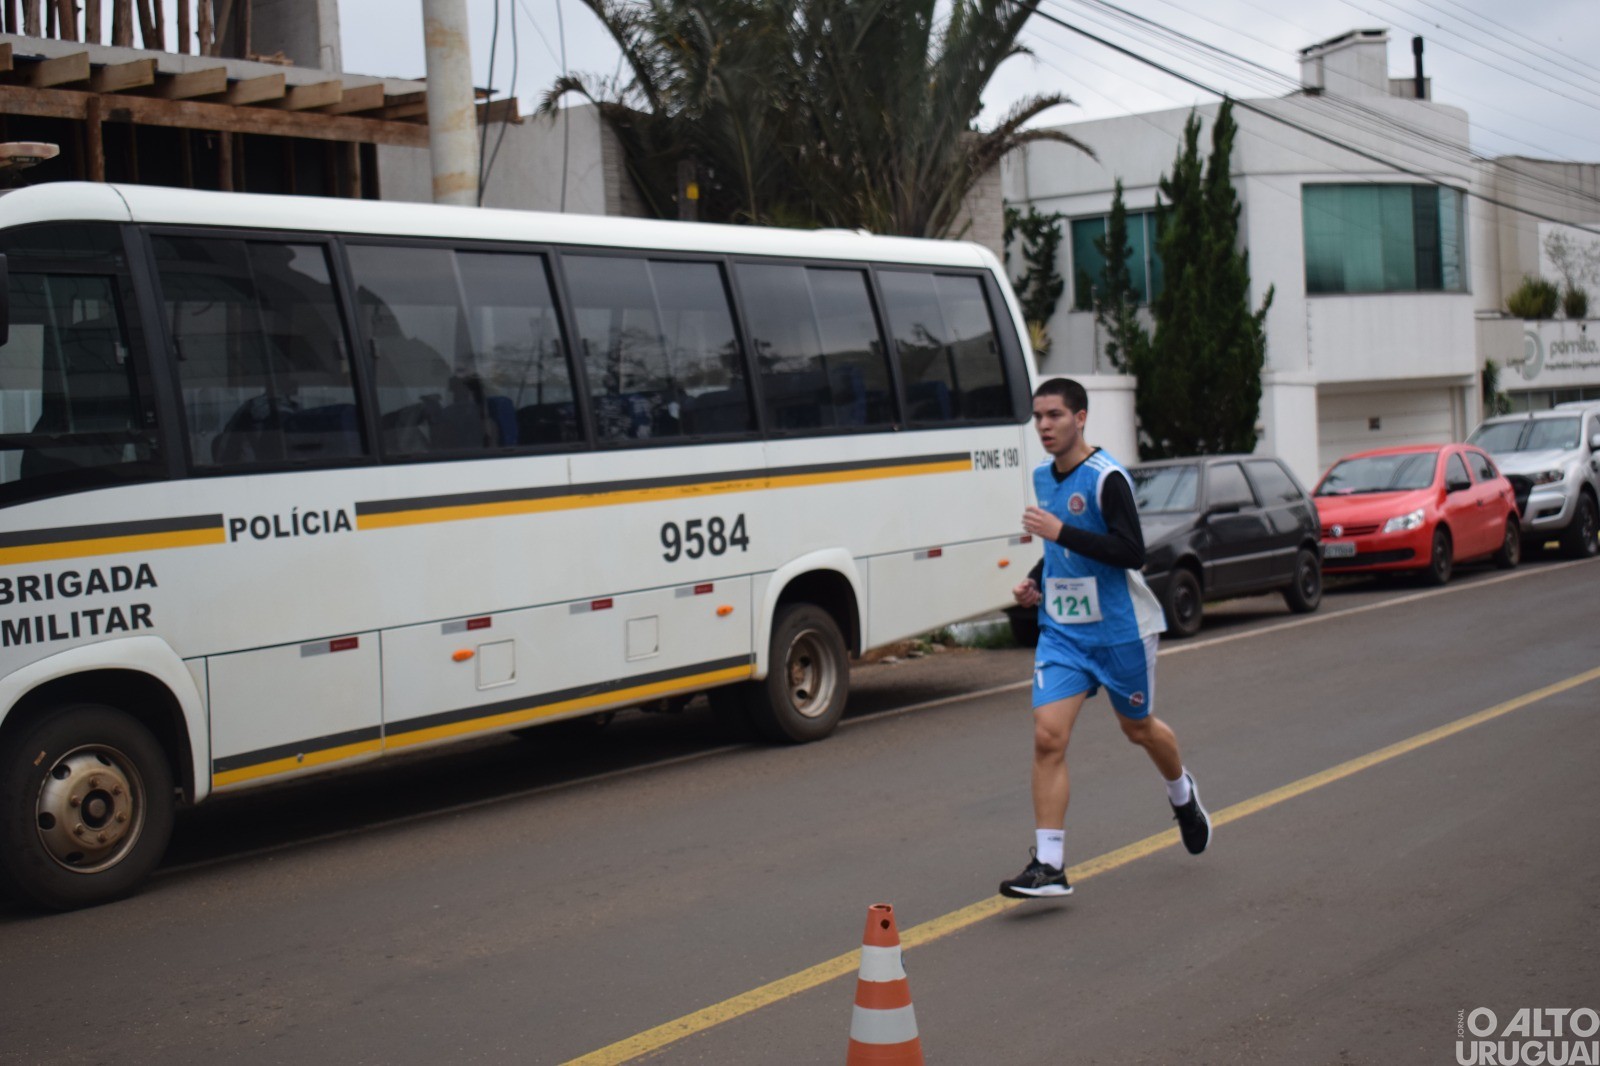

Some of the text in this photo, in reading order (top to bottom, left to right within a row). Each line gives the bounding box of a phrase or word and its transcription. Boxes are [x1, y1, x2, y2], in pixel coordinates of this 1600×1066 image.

[974, 447, 1019, 470] FONE 190
[229, 506, 352, 543] POLÍCIA
[660, 513, 750, 563] 9584
[0, 563, 158, 605] BRIGADA
[1, 603, 154, 647] MILITAR
[1052, 595, 1092, 616] 121
